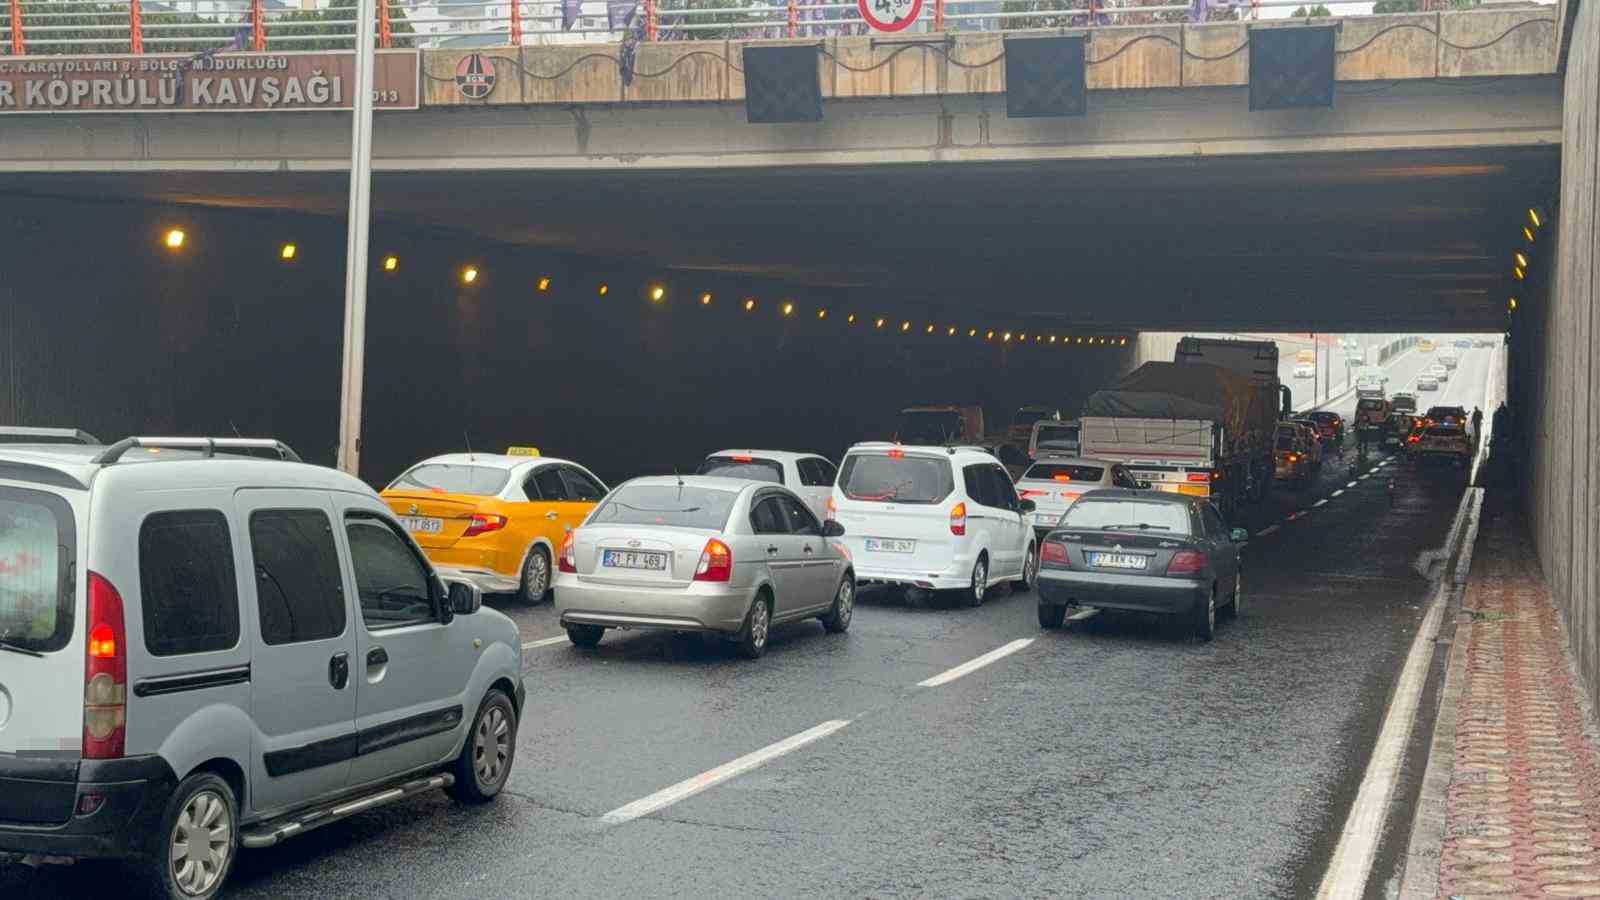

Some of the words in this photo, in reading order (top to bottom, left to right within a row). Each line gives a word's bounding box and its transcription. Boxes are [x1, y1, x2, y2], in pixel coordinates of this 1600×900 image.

[18, 60, 118, 73] KARAYOLLARI
[141, 59, 188, 72] BÖLG
[0, 80, 15, 105] R
[25, 73, 176, 106] KÖPRÜLÜ
[191, 69, 341, 107] KAVŞAĞI
[371, 91, 399, 102] 013
